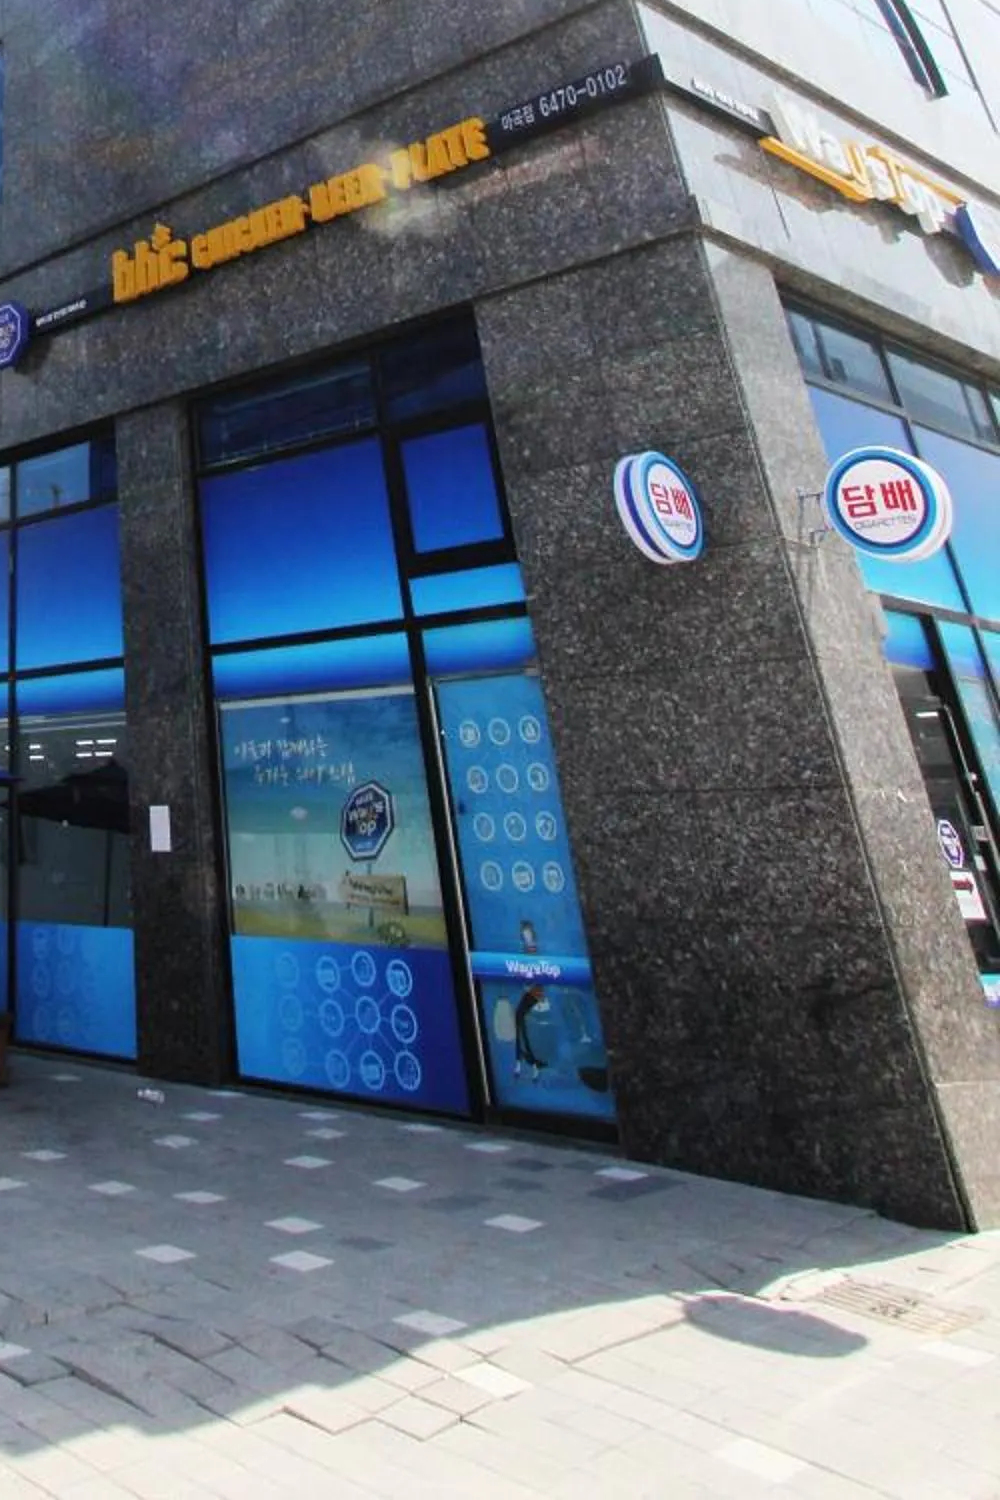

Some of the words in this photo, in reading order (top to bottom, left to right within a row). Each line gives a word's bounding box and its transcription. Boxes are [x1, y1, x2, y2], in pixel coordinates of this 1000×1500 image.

[501, 103, 535, 131] 마곡점
[539, 65, 627, 117] 6470-0102
[650, 483, 693, 521] 담배
[842, 479, 918, 519] 담배
